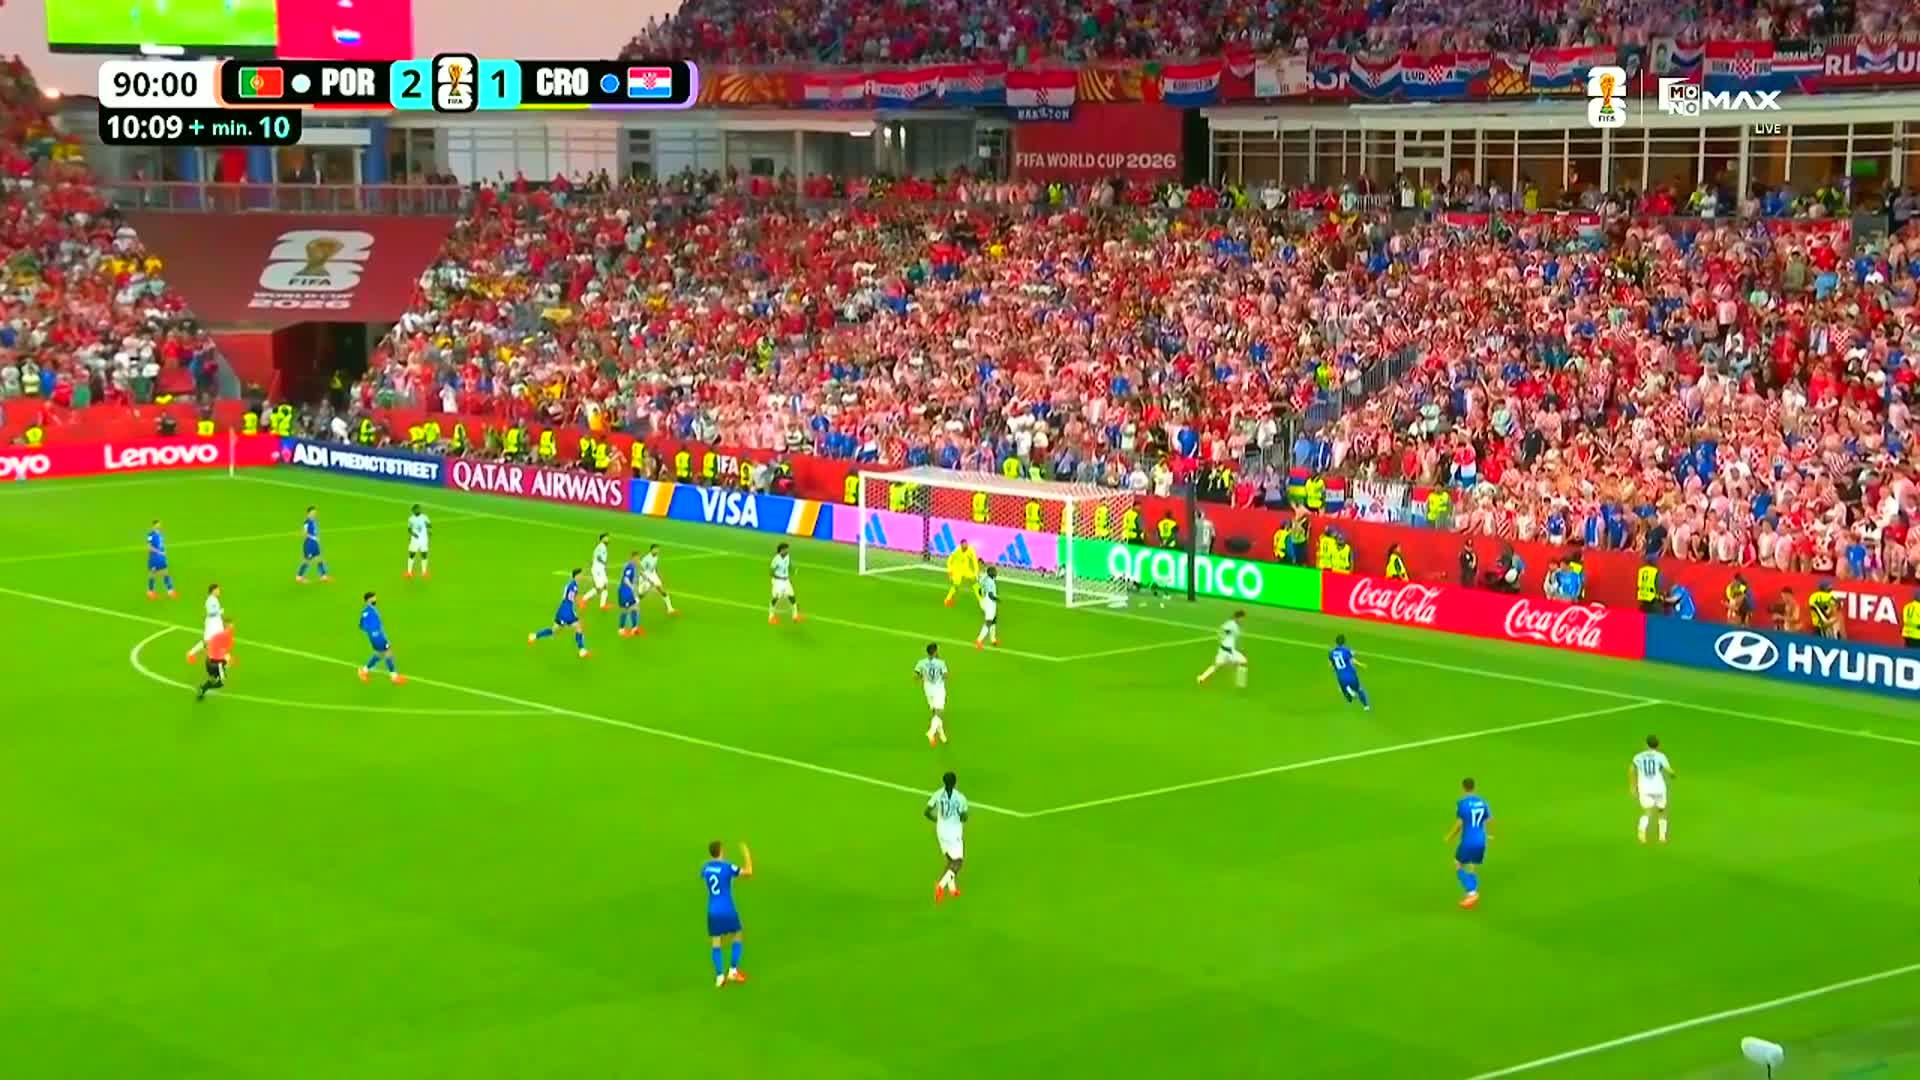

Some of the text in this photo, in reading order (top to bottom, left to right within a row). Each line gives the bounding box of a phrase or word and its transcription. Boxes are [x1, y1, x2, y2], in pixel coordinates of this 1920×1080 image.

[1016, 153, 1176, 169] FIFA WORLD CUP 2026
[288, 278, 331, 286] FIFA
[248, 299, 350, 309] 2026
[104, 444, 218, 469] Lenovo
[293, 443, 439, 480] ADI PREDICTSTREET
[716, 455, 739, 476] IFA
[453, 461, 623, 506] QATAR AIRWAYS
[696, 486, 758, 528] VISA
[1108, 545, 1263, 599] aramco
[1349, 577, 1442, 624] Coca-Cola
[1505, 598, 1608, 648] Coca-Cola
[1787, 642, 1920, 691] HYUND
[1643, 759, 1656, 777] 10
[1471, 808, 1485, 828] 17
[709, 874, 720, 896] 2
